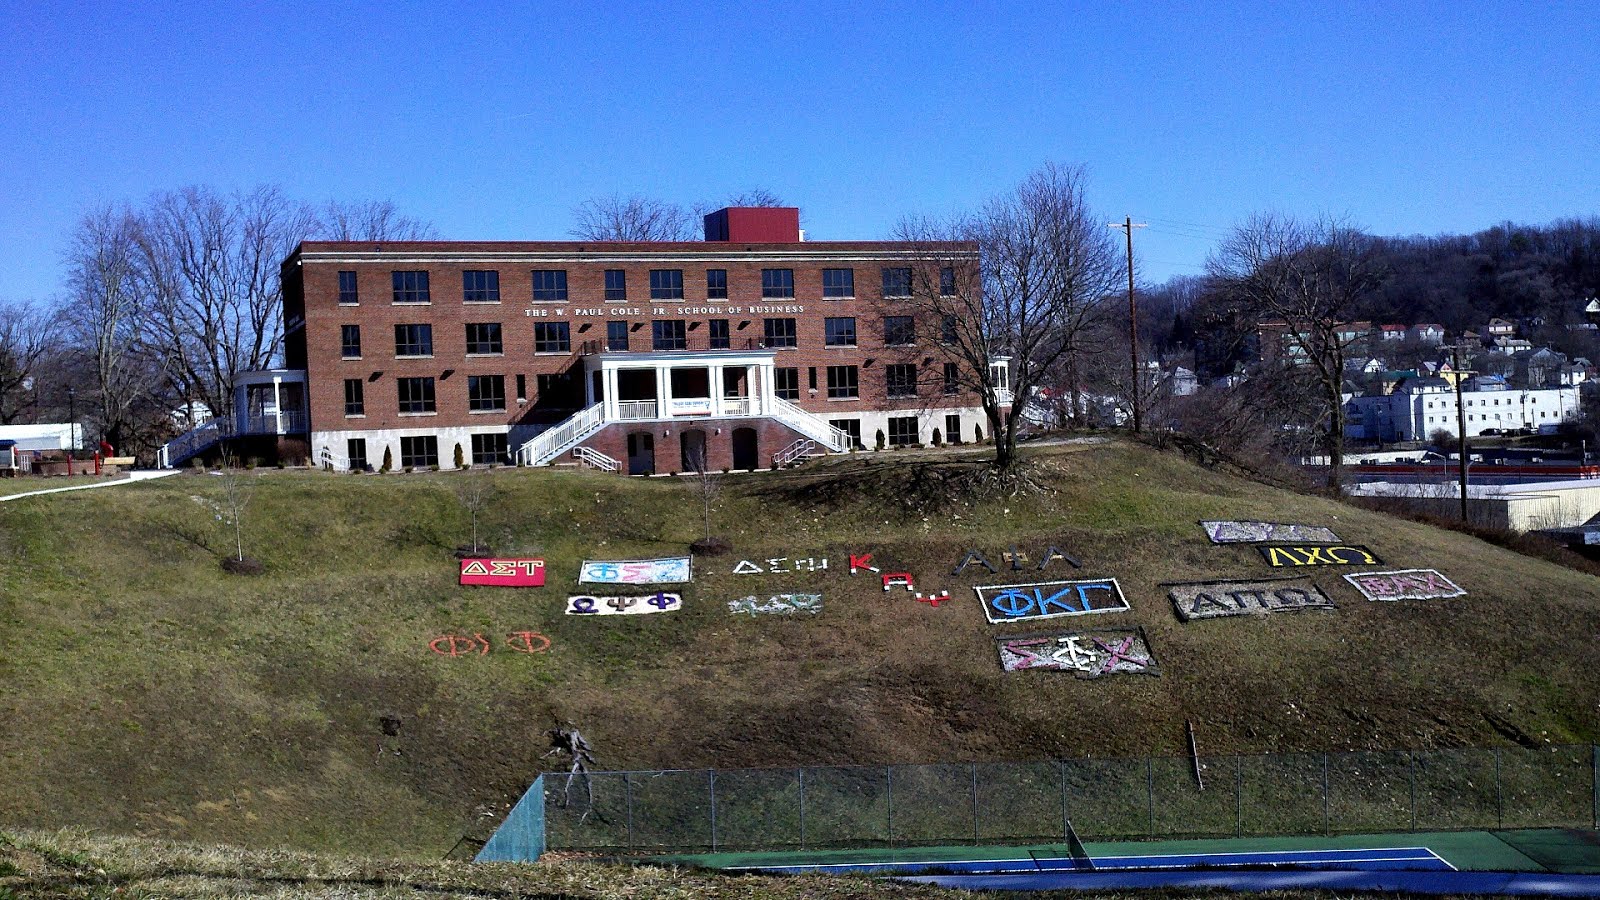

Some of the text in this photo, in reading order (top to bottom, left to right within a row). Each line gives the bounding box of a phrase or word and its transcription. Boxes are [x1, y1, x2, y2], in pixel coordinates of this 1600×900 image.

[524, 309, 548, 317] THE
[575, 308, 604, 316] PAUL
[677, 306, 723, 315] SCHOOL
[727, 306, 743, 314] OF
[749, 305, 805, 314] BUSINESS
